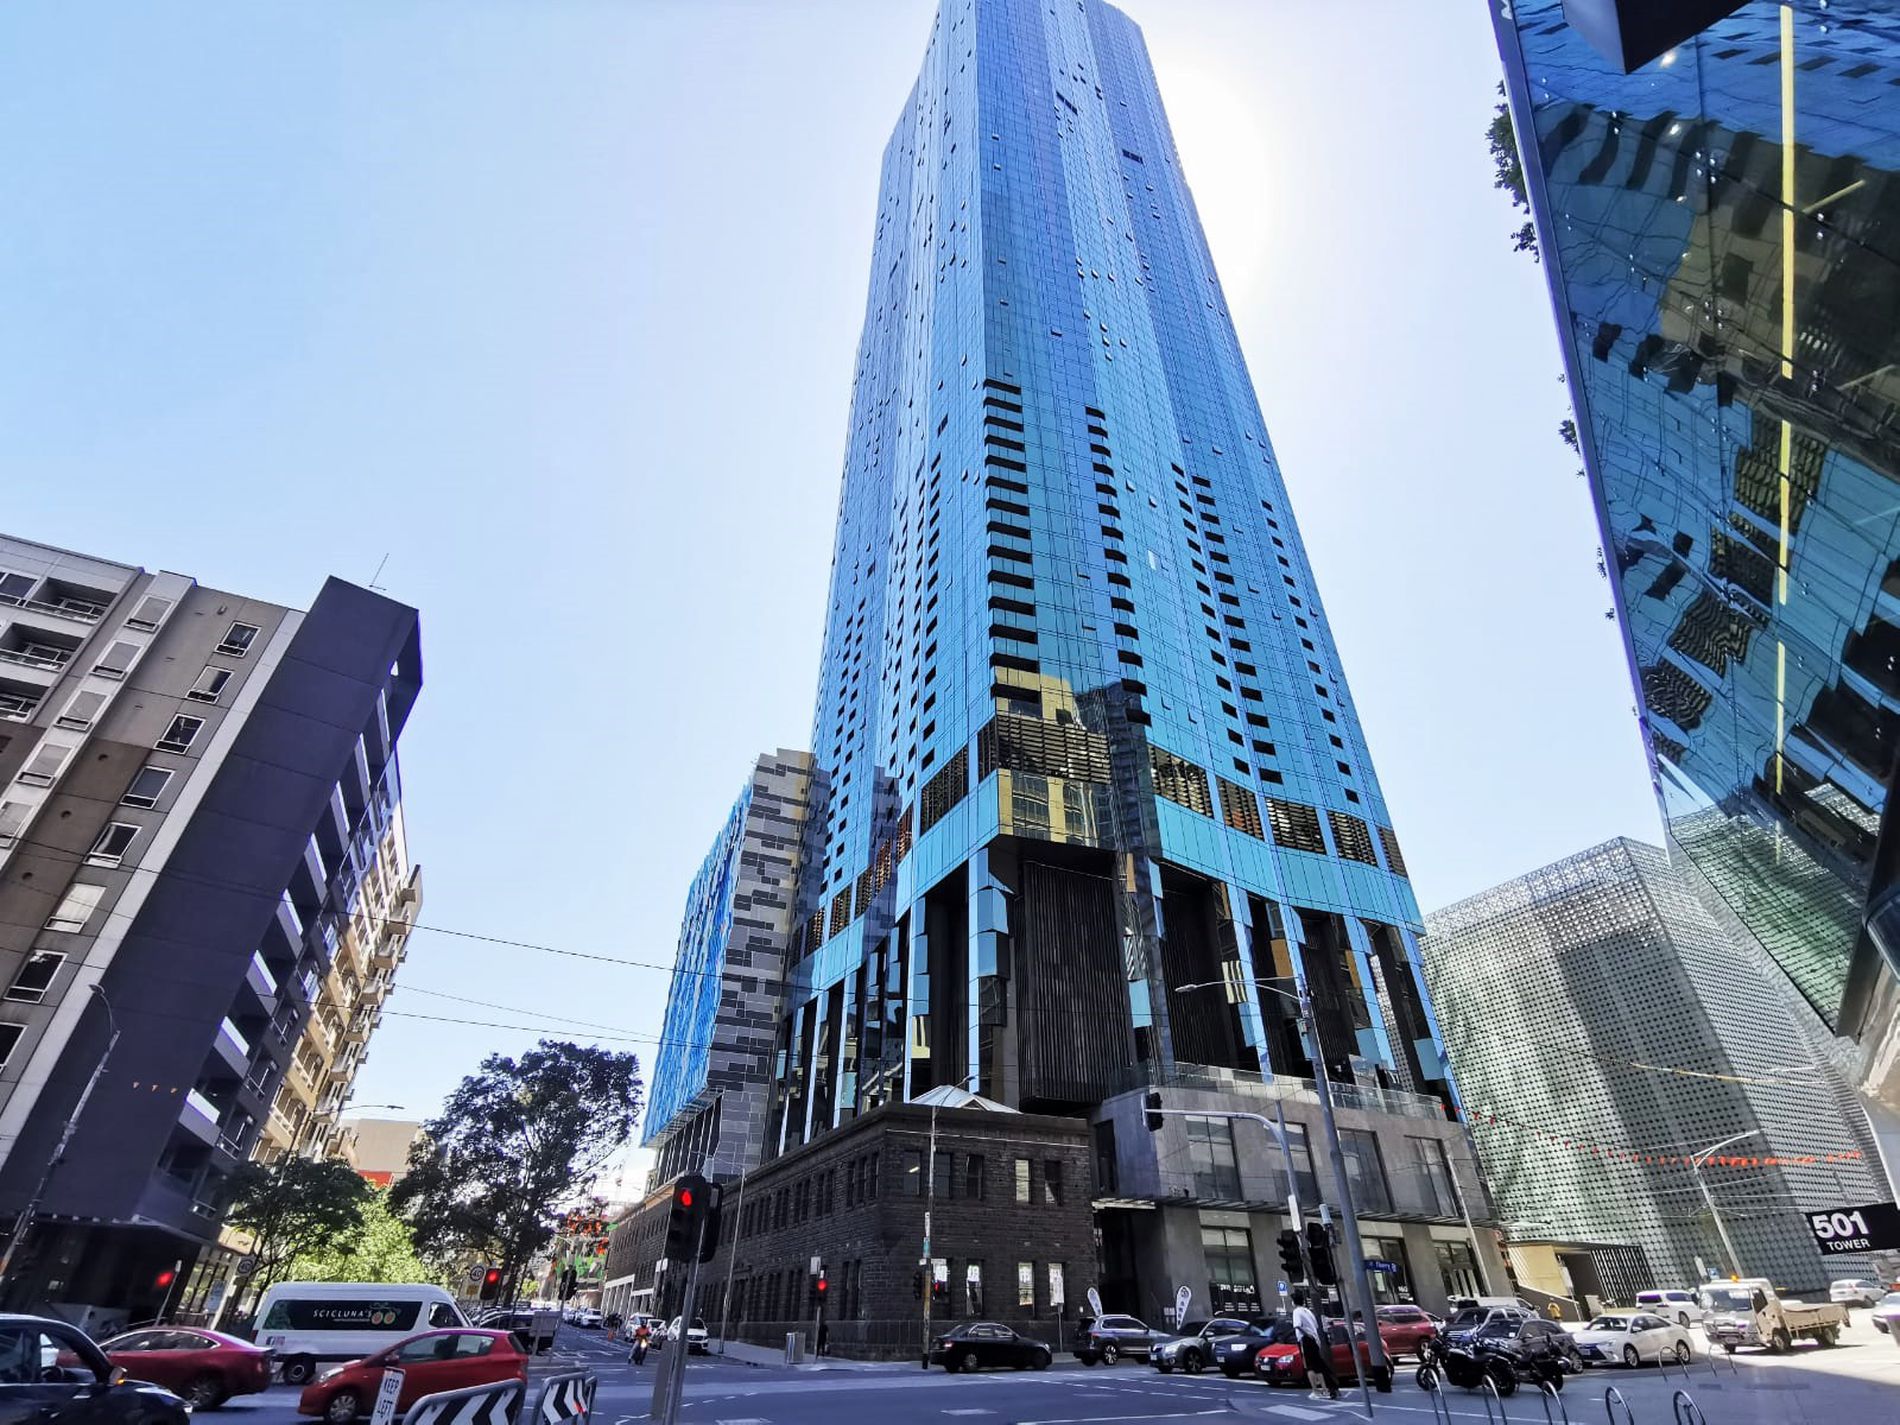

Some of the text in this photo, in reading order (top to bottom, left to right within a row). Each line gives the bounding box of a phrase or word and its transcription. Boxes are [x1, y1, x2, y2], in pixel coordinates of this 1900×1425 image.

[1812, 1210, 1869, 1239] 501
[1826, 1238, 1871, 1252] TOWER
[313, 1308, 373, 1319] SCICLUNA'S
[384, 1378, 400, 1395] KEEP
[377, 1399, 393, 1418] LEFT
